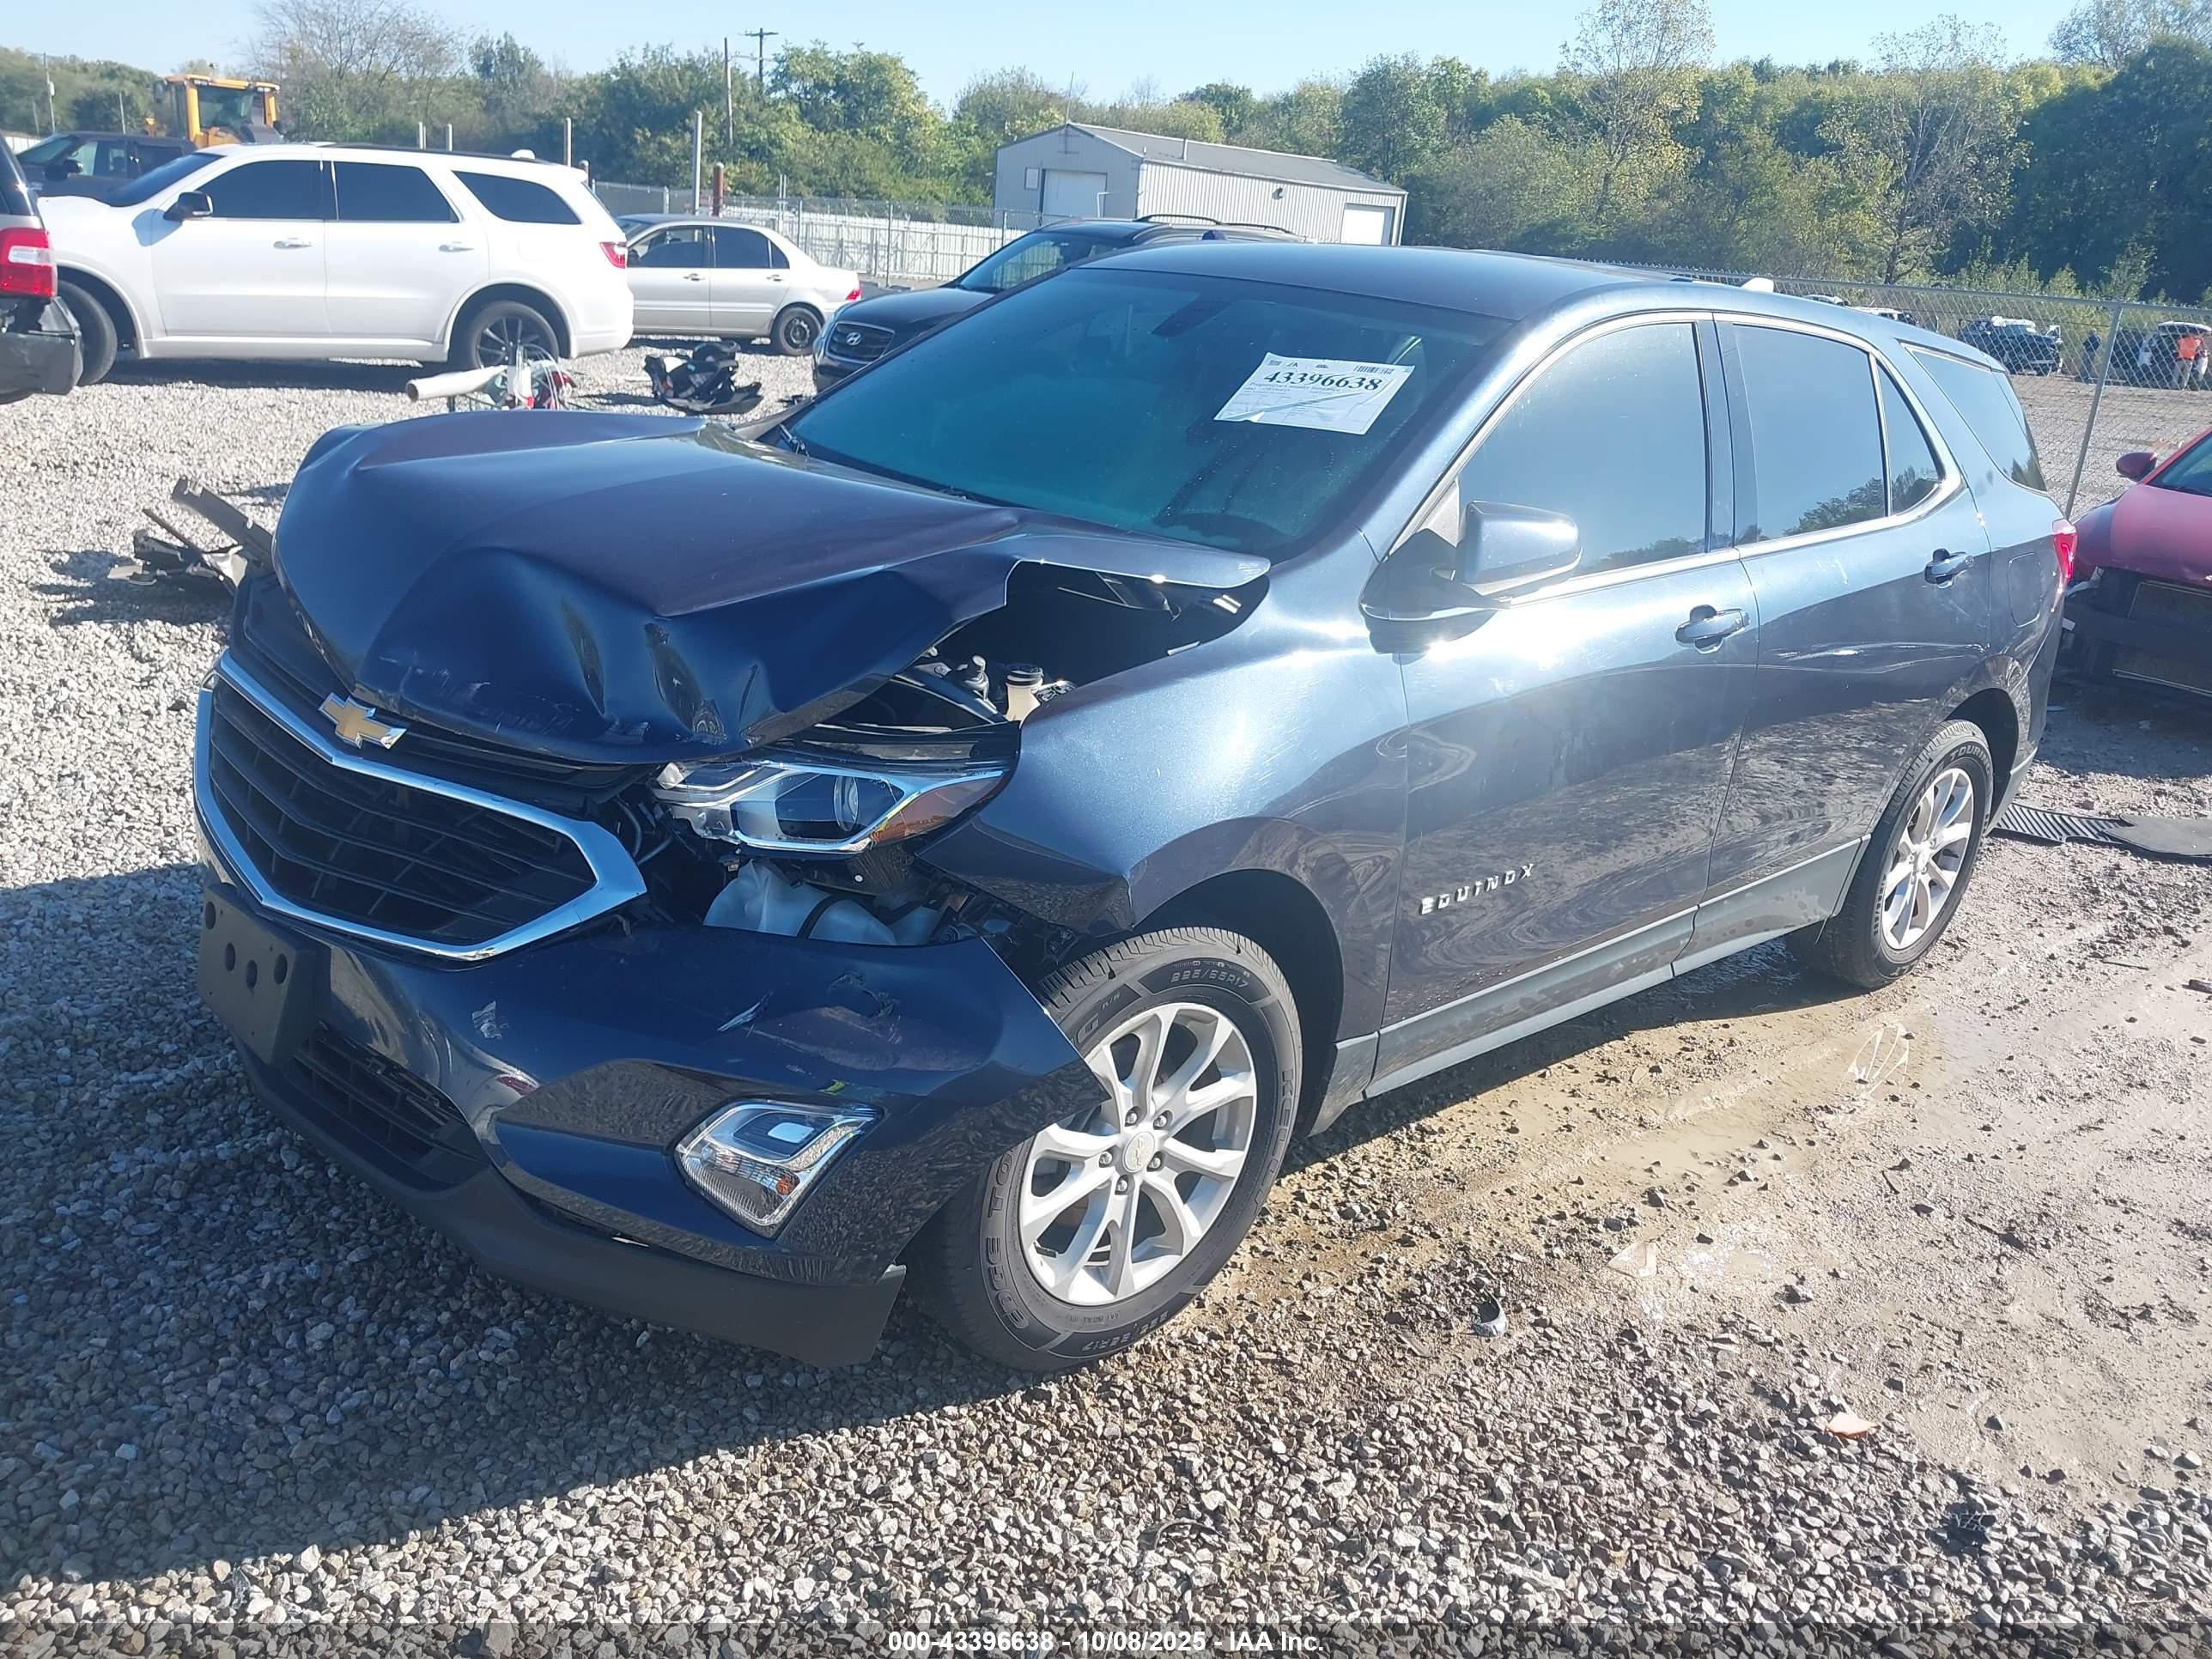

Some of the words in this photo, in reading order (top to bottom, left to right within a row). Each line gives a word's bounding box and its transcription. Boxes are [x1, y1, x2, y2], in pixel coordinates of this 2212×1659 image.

[1263, 371, 1382, 391] 43396638
[1949, 744, 1992, 774] TOURING
[1419, 863, 1534, 915] EQUINOX
